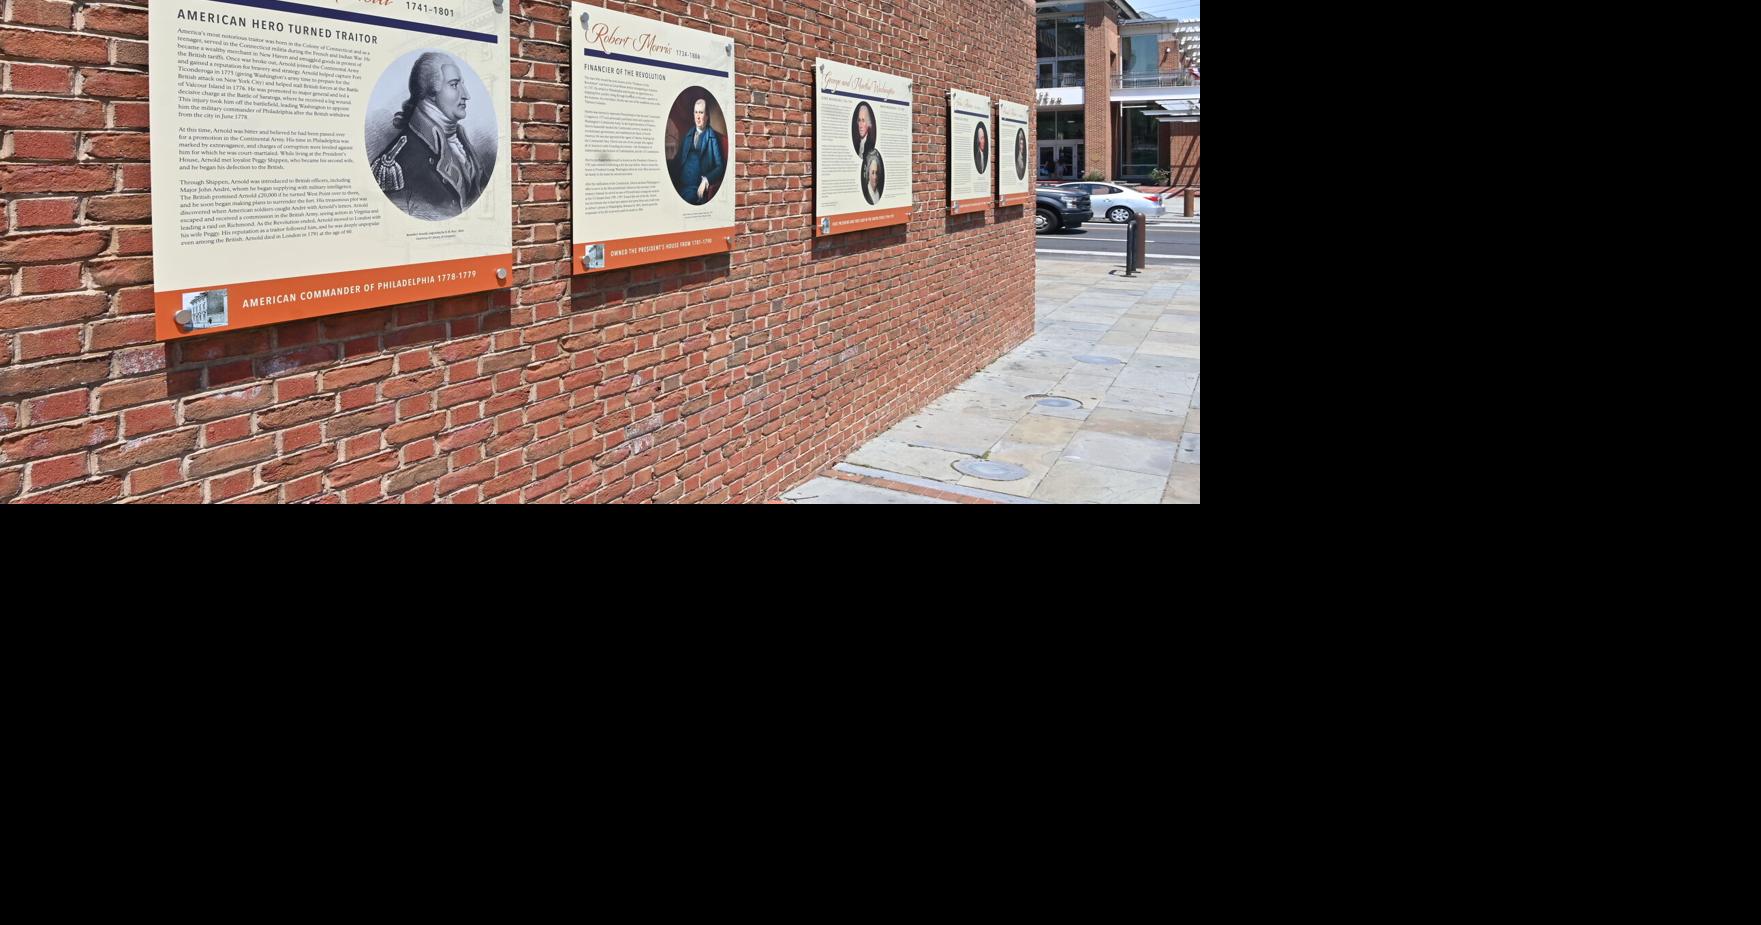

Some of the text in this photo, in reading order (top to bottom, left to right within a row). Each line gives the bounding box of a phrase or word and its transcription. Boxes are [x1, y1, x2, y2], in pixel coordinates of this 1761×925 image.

[406, 1, 455, 17] 1741-1801
[176, 9, 378, 44] AMERICAN HERO TURNED TRAITOR
[177, 28, 206, 36] America's
[585, 22, 632, 54] Robert
[632, 33, 672, 55] Morris
[190, 59, 209, 68] gained
[584, 63, 615, 74] FINANCIER
[624, 69, 634, 77] THE
[635, 70, 666, 80] REVOLUTION
[180, 216, 204, 224] escaped
[180, 224, 202, 232] leading
[610, 248, 628, 257] OWNED
[638, 244, 665, 253] PRESIDENT'S
[242, 270, 477, 308] AMERICAN COMMANDER OF PHILADELPHIA 1778-1779
